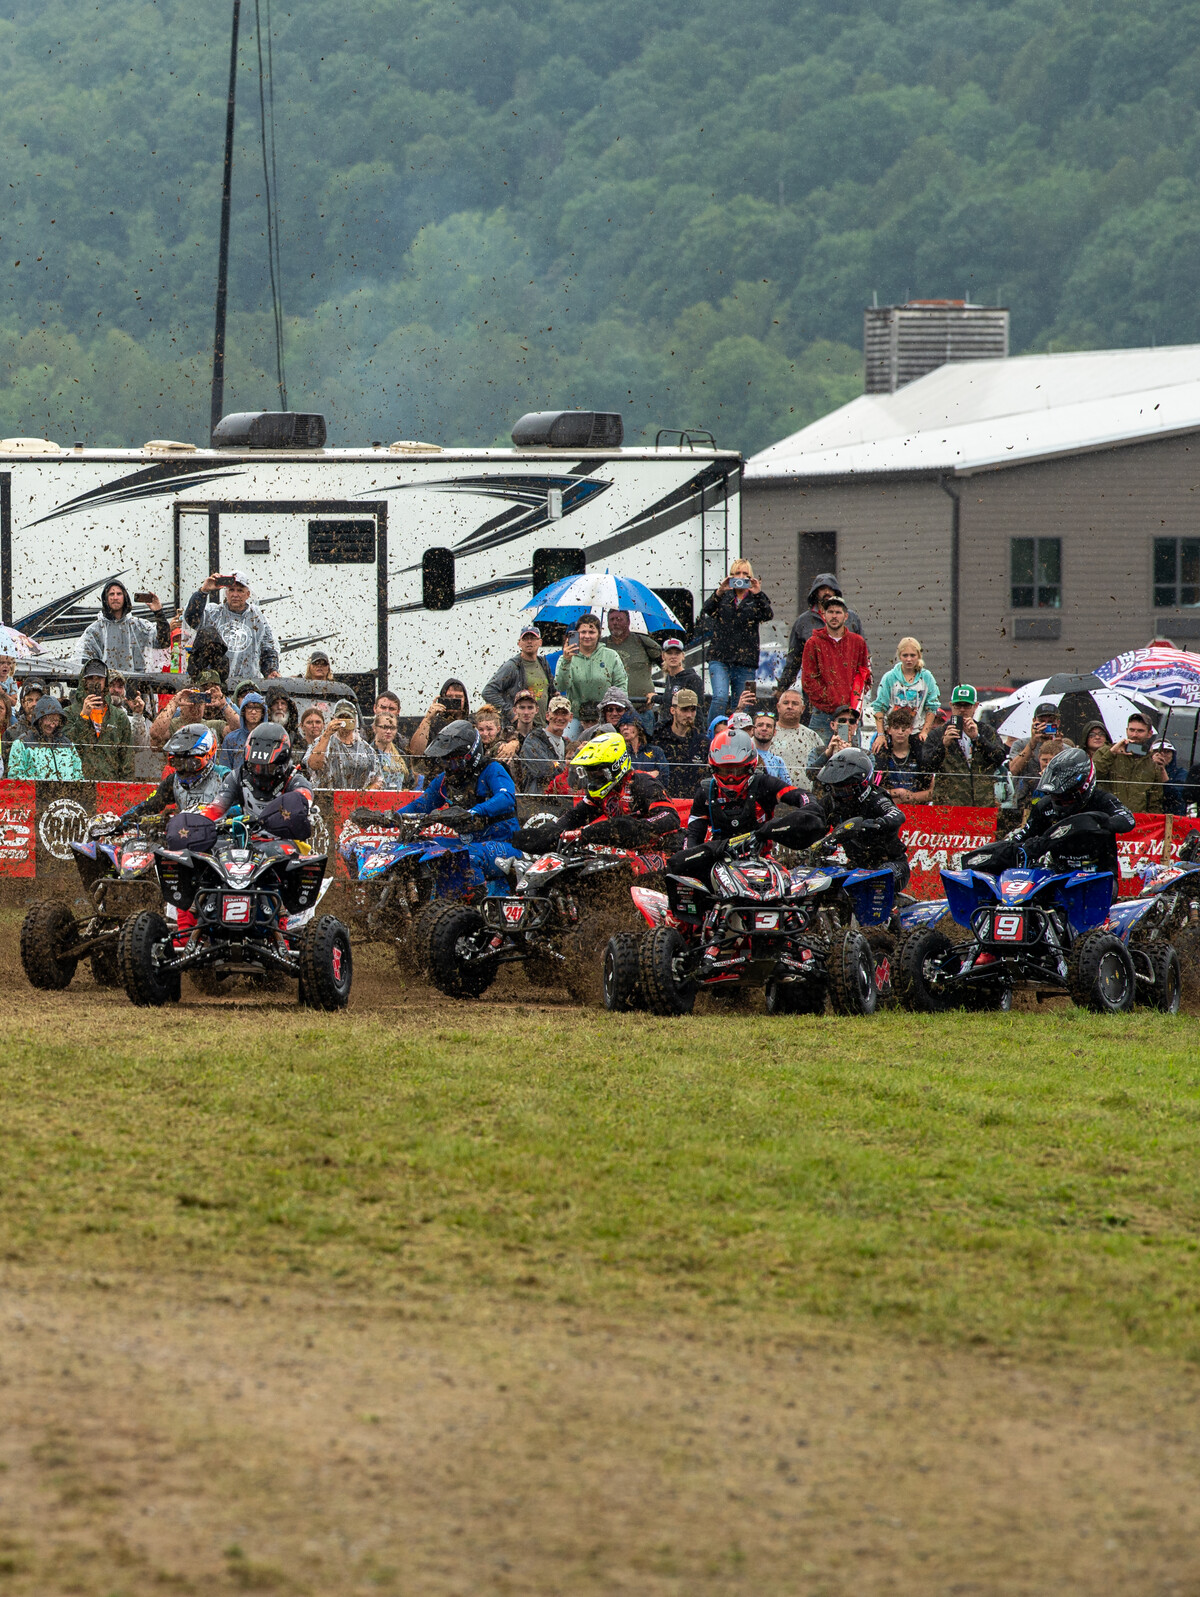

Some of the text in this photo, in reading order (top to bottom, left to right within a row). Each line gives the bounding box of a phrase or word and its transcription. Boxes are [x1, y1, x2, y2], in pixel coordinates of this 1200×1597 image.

[1181, 684, 1200, 694] MO
[251, 751, 270, 760] FLY
[900, 830, 992, 850] MOUNTAIN
[1004, 882, 1029, 893] 9
[225, 901, 248, 922] 2
[505, 906, 523, 923] 241
[755, 911, 779, 929] 3
[996, 916, 1020, 936] 9
